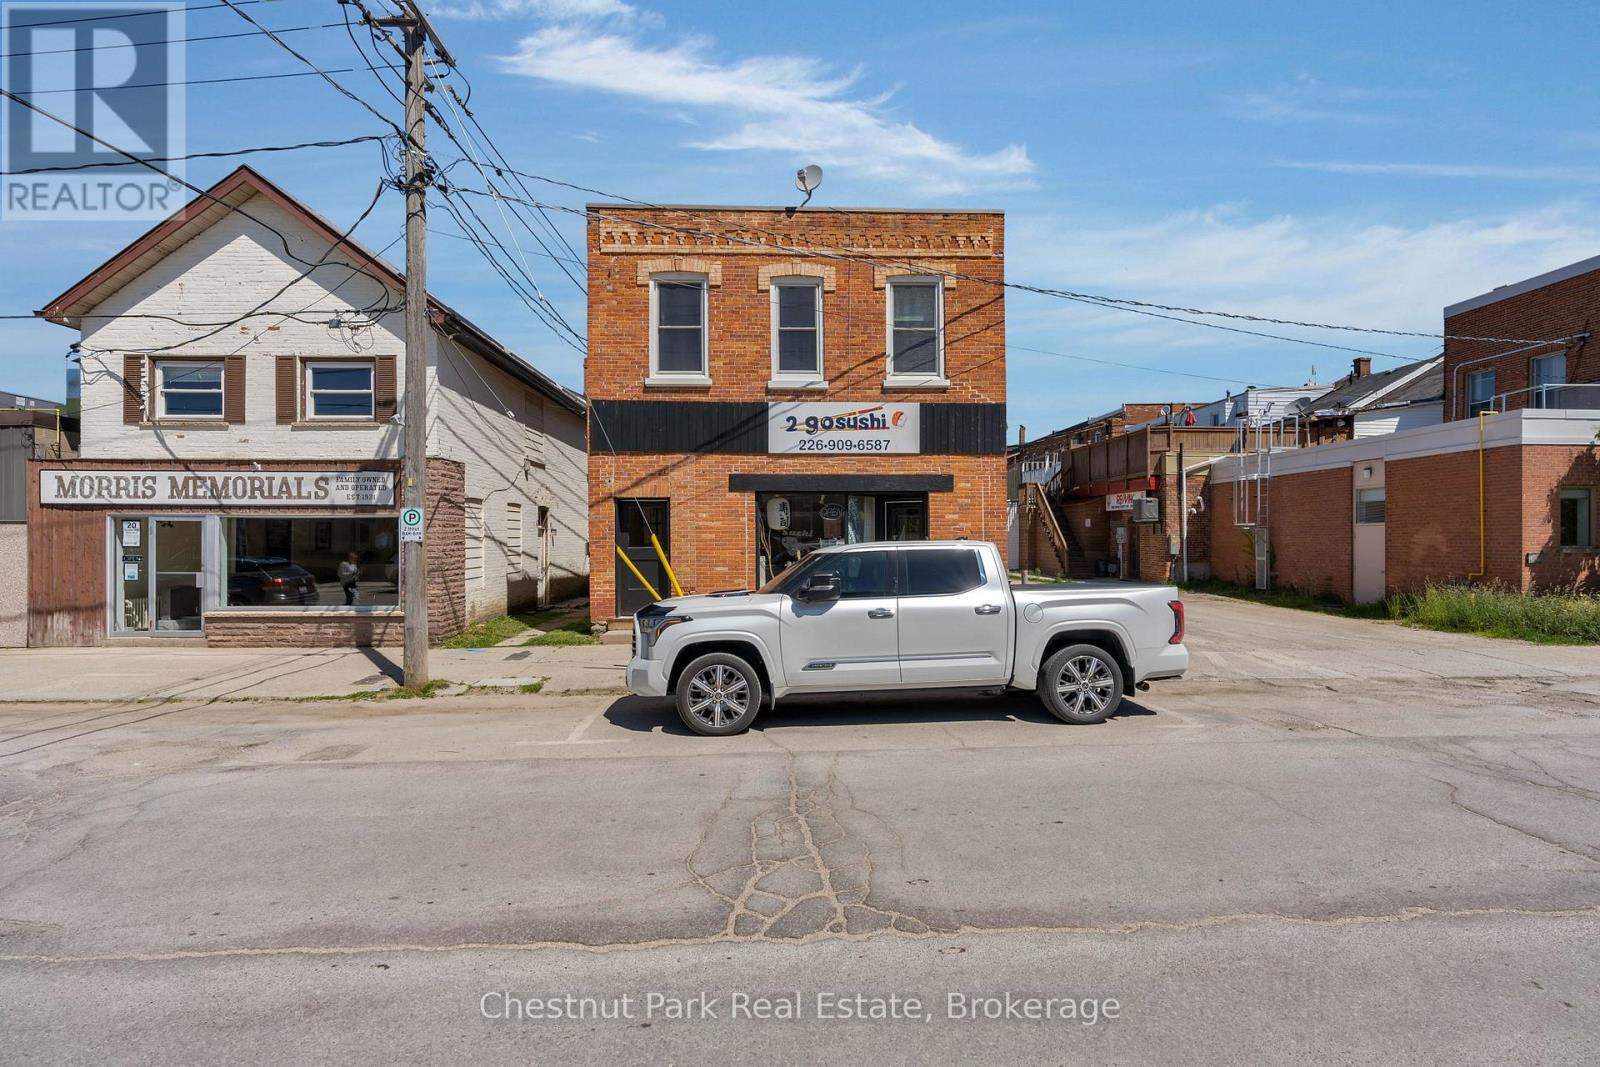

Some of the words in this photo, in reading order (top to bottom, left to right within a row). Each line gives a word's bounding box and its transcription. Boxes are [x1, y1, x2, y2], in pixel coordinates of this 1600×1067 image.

[54, 475, 157, 499] MORRIS
[167, 476, 329, 500] MEMORIALS
[408, 513, 417, 523] P
